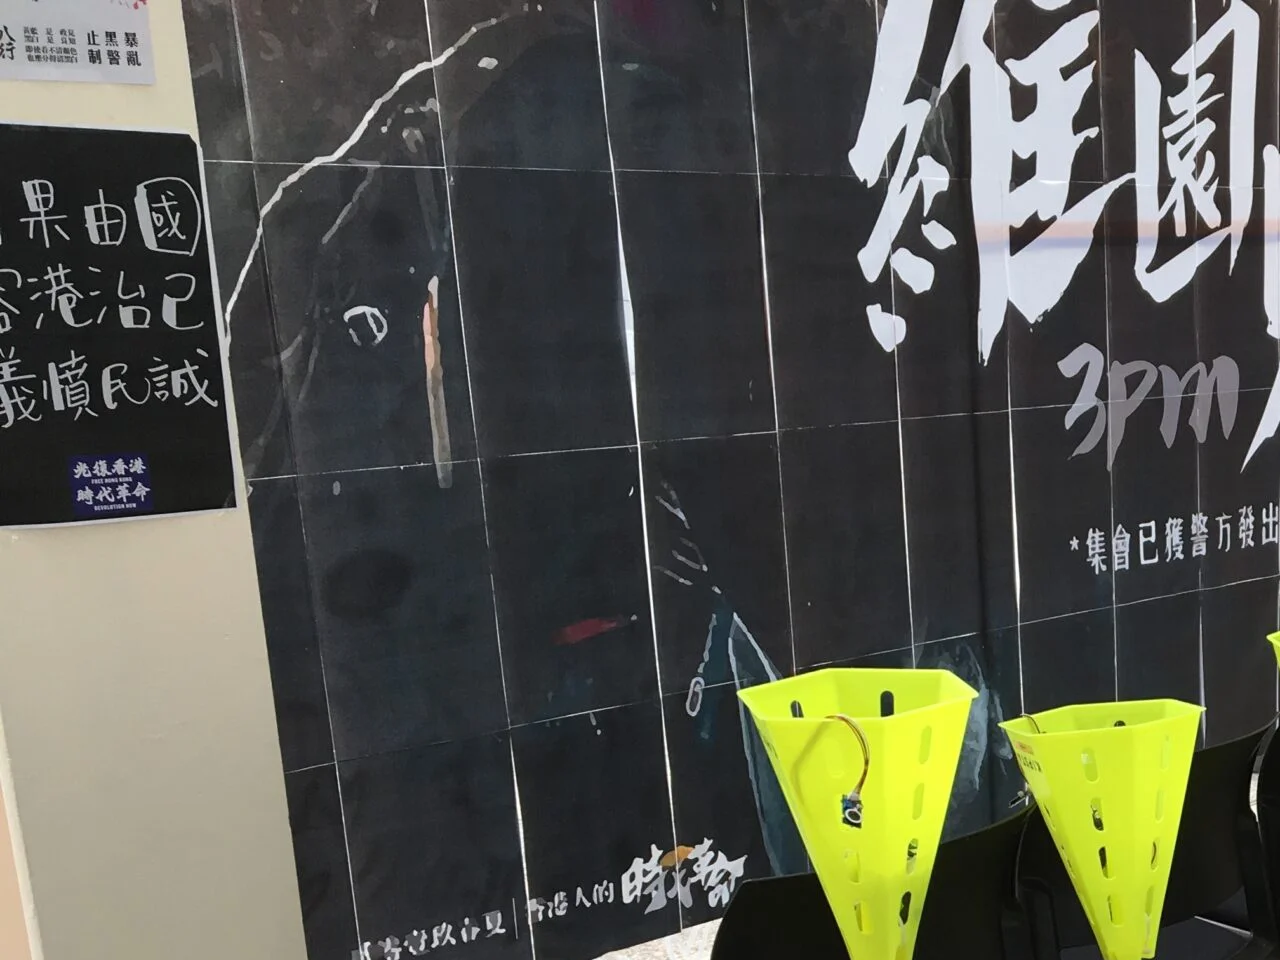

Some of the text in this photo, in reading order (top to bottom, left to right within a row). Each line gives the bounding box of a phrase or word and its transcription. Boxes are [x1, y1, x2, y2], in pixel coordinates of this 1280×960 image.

[0, 176, 200, 256] 果由國
[1057, 343, 1240, 471] 3pm
[73, 457, 147, 479] 光復香港
[76, 482, 151, 505] 時代革命
